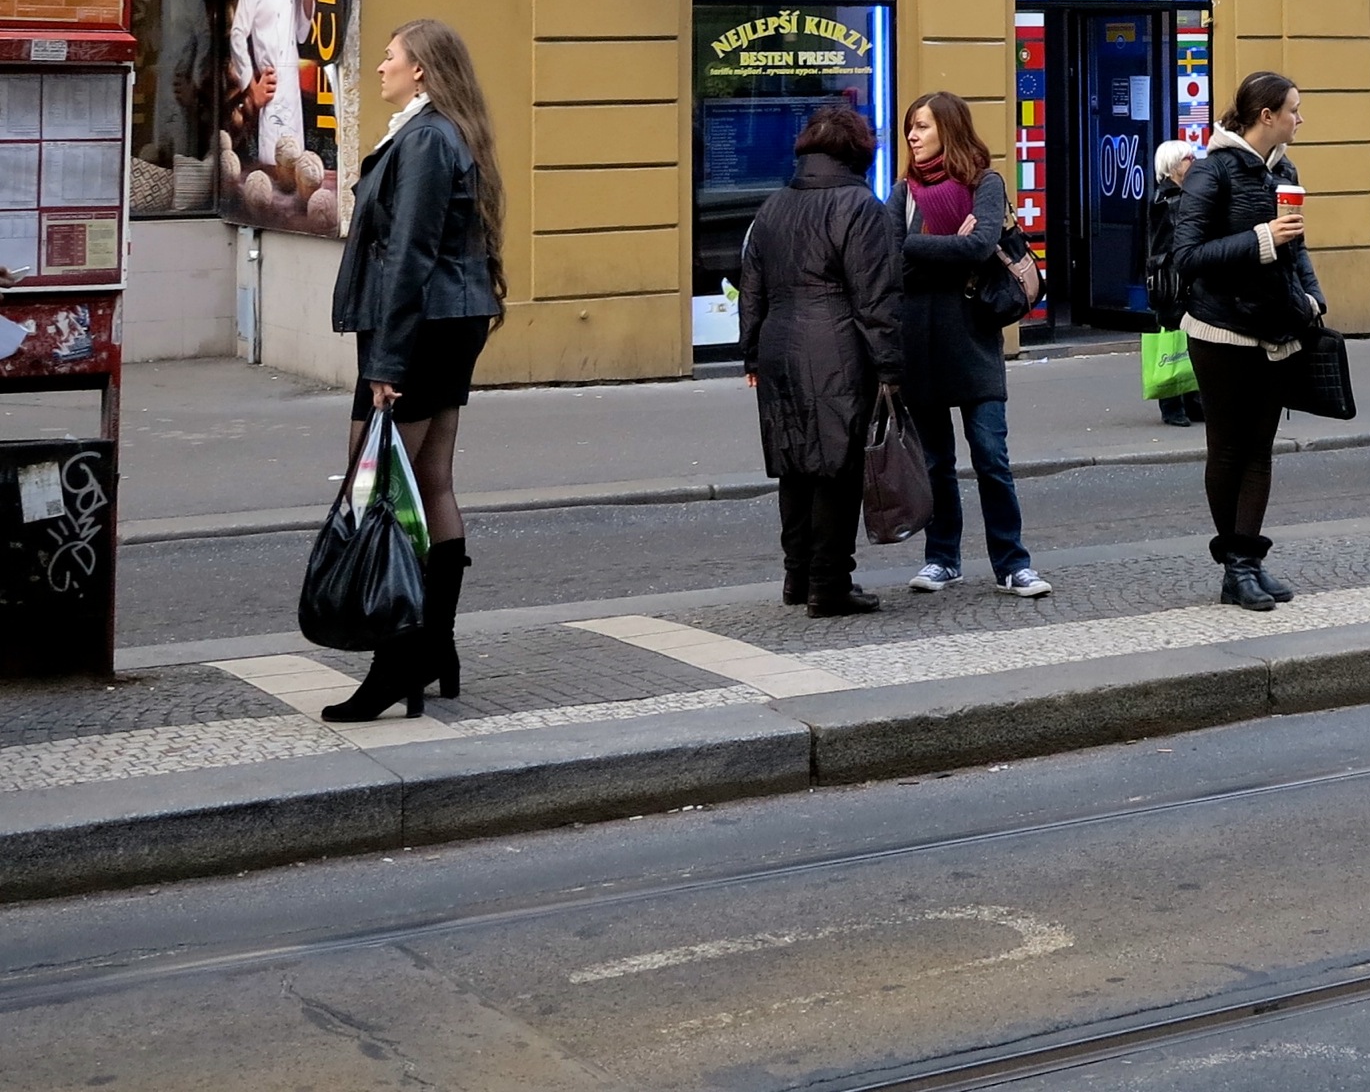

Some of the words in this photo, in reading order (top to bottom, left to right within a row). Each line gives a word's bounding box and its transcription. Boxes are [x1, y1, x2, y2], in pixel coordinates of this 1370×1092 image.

[711, 10, 800, 58] NEJLEPŠÍ
[804, 15, 873, 57] KURZY
[739, 51, 794, 66] BESTEN
[798, 51, 846, 66] PREISE
[1101, 134, 1145, 200] 0%
